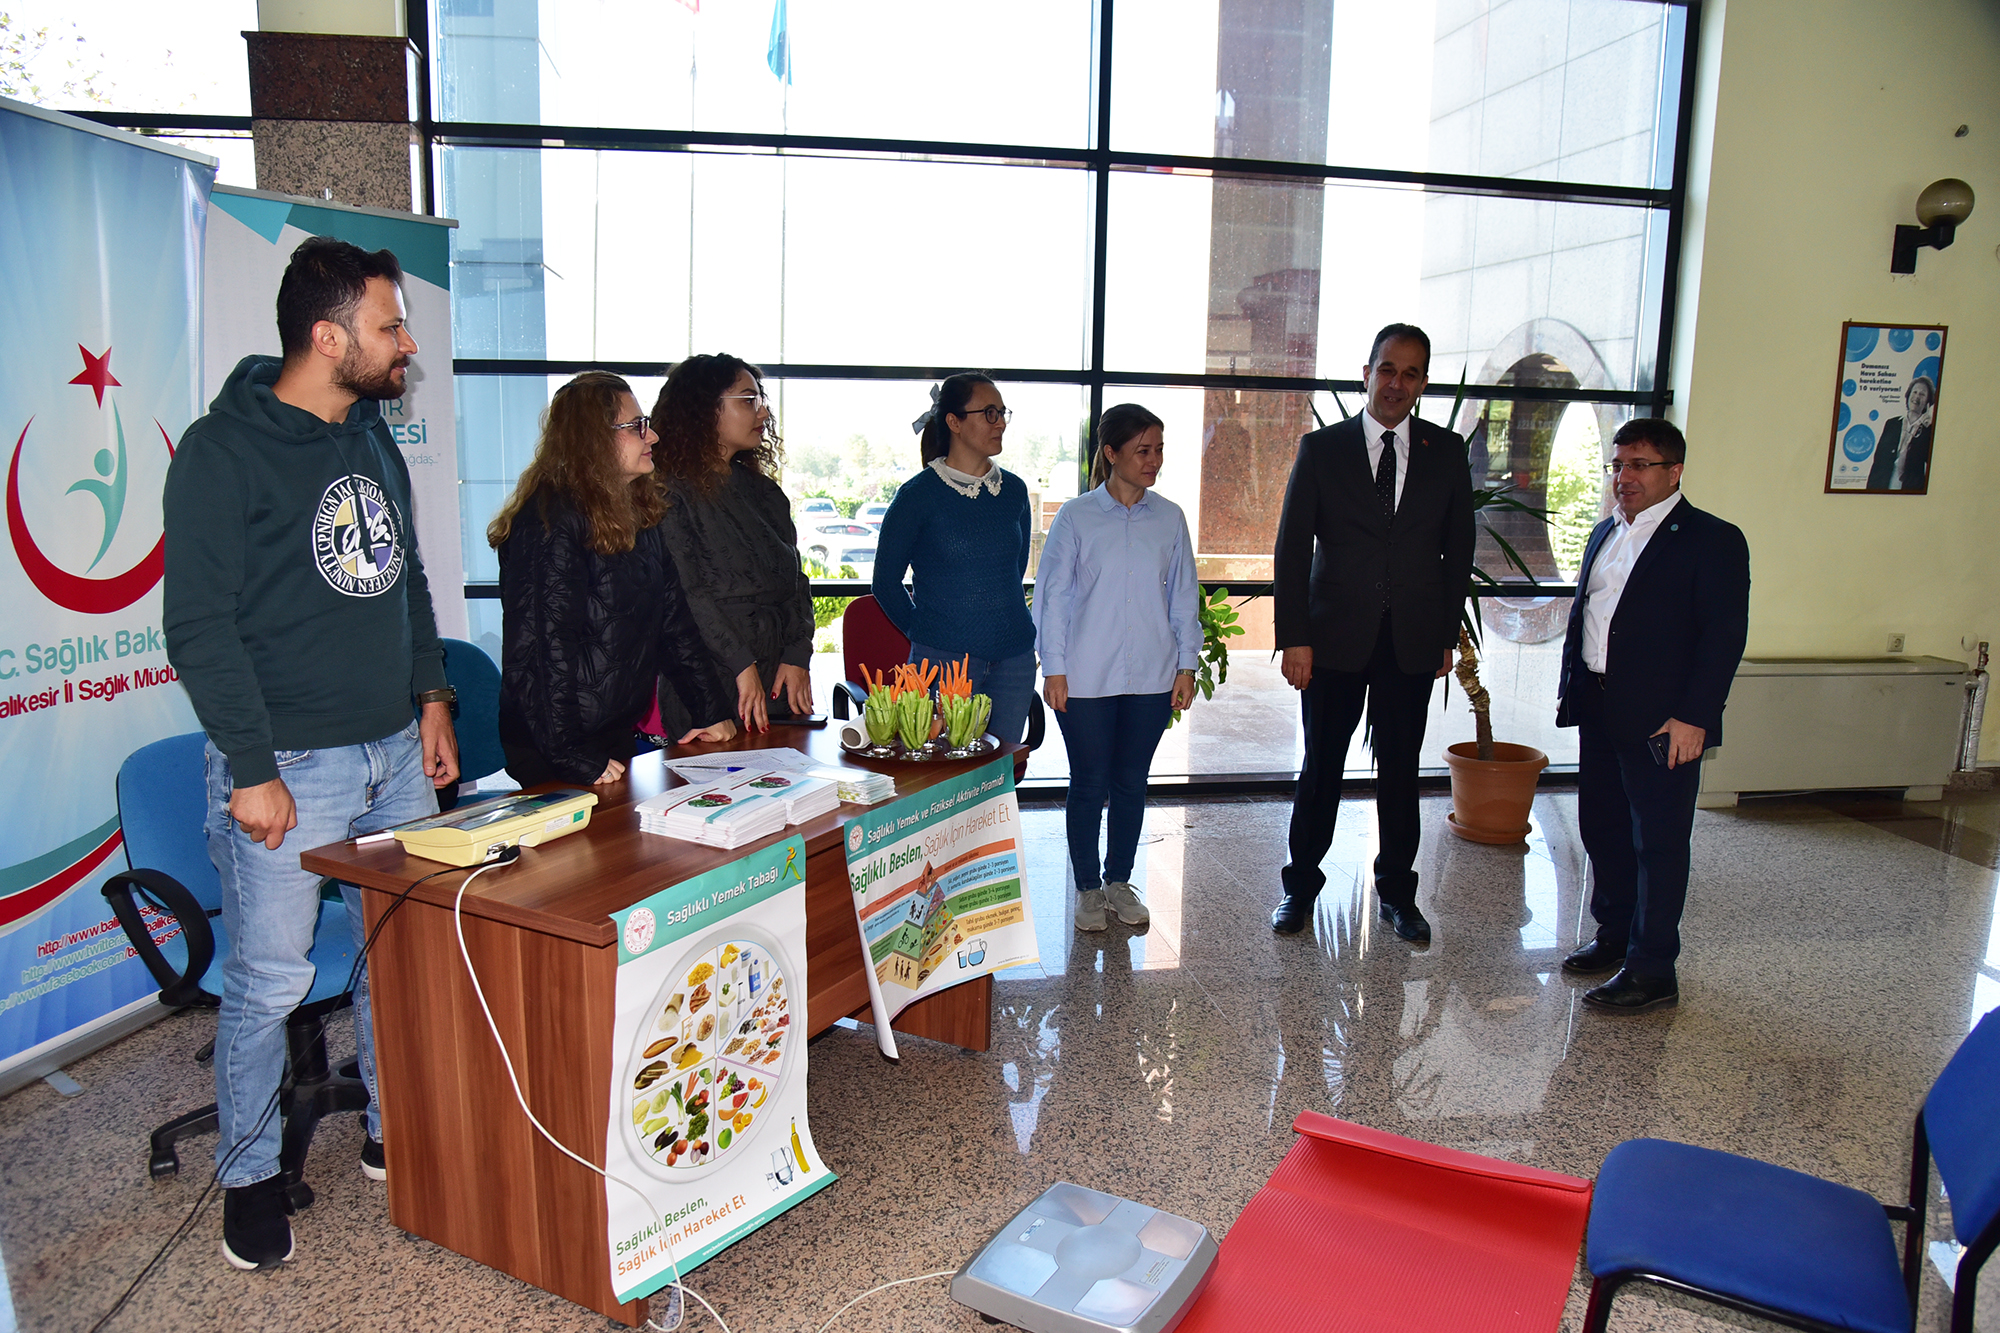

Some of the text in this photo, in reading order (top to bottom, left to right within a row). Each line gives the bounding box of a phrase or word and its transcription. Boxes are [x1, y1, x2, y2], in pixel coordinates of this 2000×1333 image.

[390, 418, 427, 444] ESİ
[319, 551, 357, 592] NINETY
[25, 634, 109, 676] Sağlık
[115, 626, 168, 659] Bak
[0, 686, 60, 719] alıkesir
[64, 679, 74, 704] İl
[78, 673, 131, 702] Sağlık
[867, 773, 1005, 845] Sağlıklı Yemek ve Fiziksel Aktivite Piramidi
[850, 857, 886, 894] Sağlıklı
[889, 844, 923, 874] Beslen,
[924, 826, 950, 857] Sağlık
[950, 820, 964, 848] İçin
[964, 807, 997, 835] Hareket
[998, 802, 1011, 823] Et
[667, 866, 779, 926] Sağlıklı Yemek Tabağı
[616, 1197, 708, 1256] Sağlıklı Beslen,
[617, 1245, 657, 1276] Sağlık
[683, 1202, 731, 1238] Hareket
[732, 1194, 746, 1210] Et
